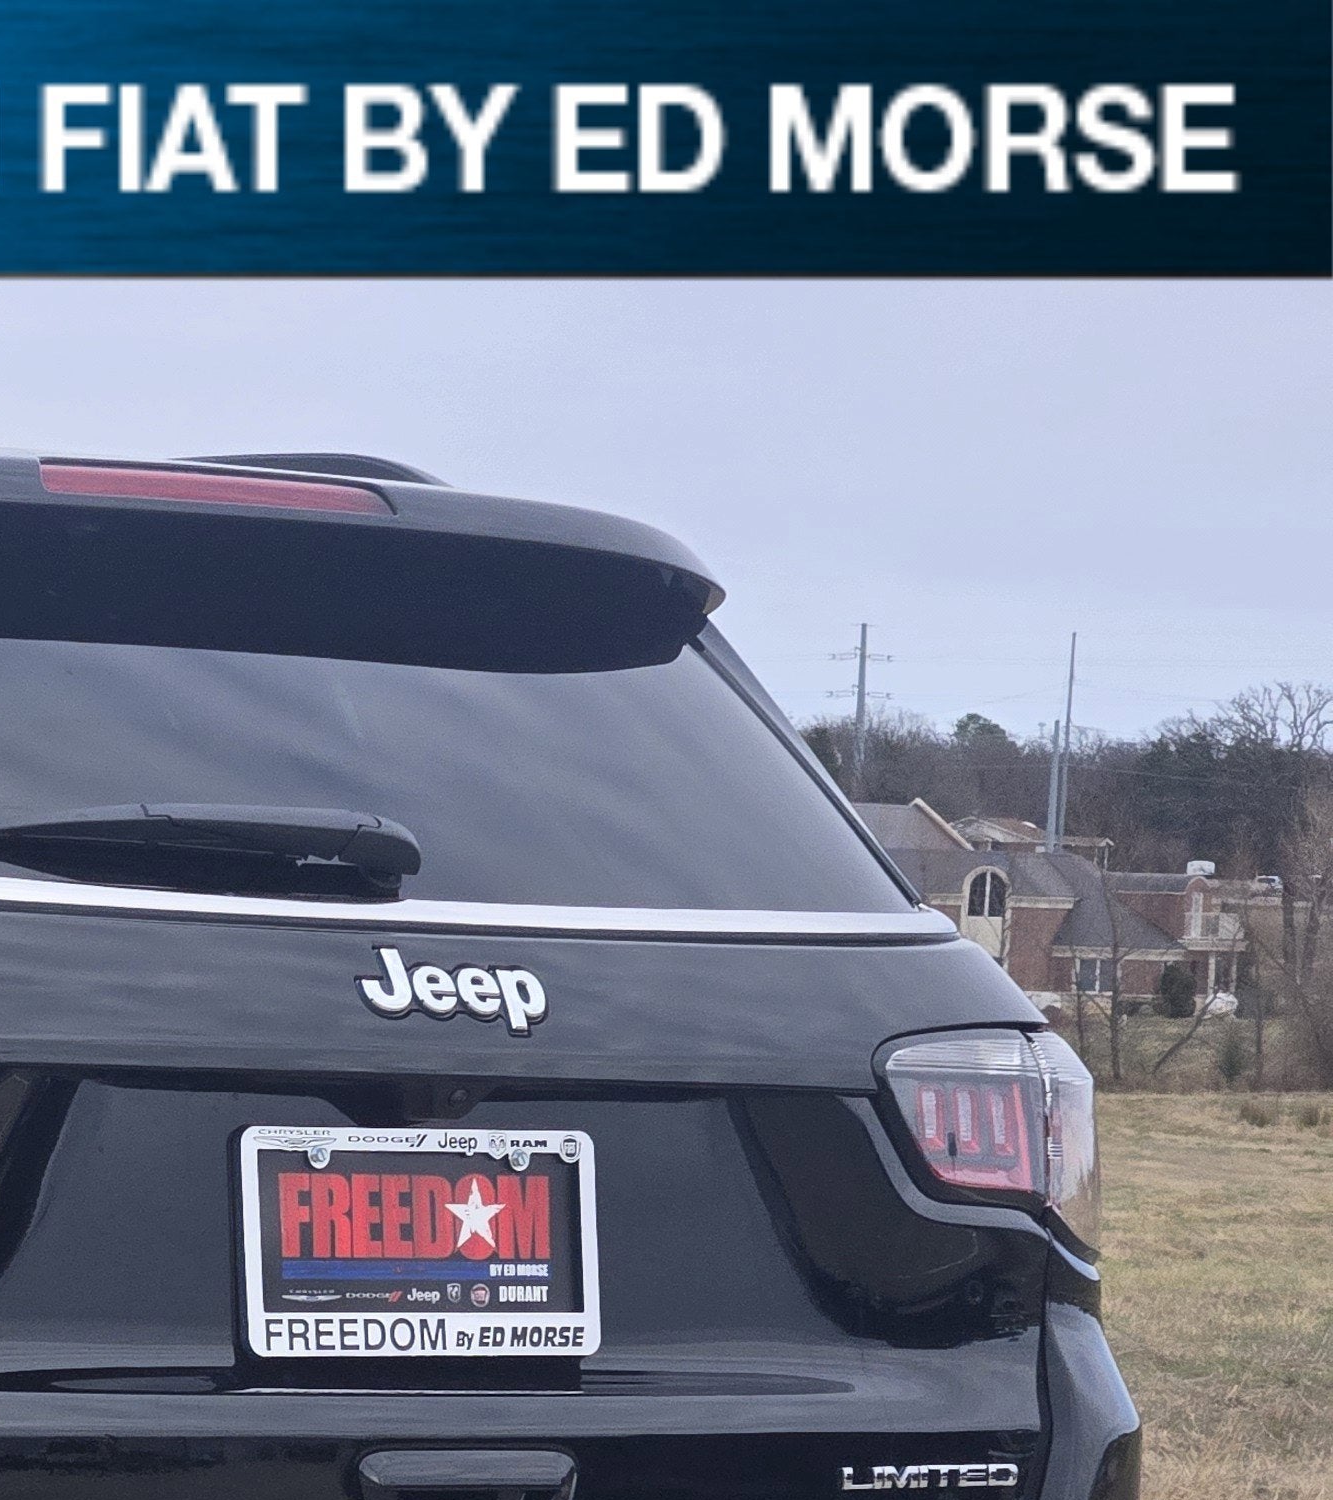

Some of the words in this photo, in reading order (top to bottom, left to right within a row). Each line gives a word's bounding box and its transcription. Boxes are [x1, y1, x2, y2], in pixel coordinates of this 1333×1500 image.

[358, 946, 547, 1033] Jeep
[258, 1128, 331, 1136] CHRYSLER
[348, 1135, 414, 1143] DODGE
[438, 1132, 478, 1151] Jeep
[510, 1139, 548, 1148] RAM
[278, 1172, 551, 1260] FREEDOM
[407, 1288, 440, 1303] Jeep
[499, 1285, 549, 1302] DURANT
[265, 1318, 448, 1351] FREEDOM
[478, 1327, 505, 1347] ED
[510, 1326, 584, 1348] MORSE
[841, 1463, 1019, 1490] LIMITED
